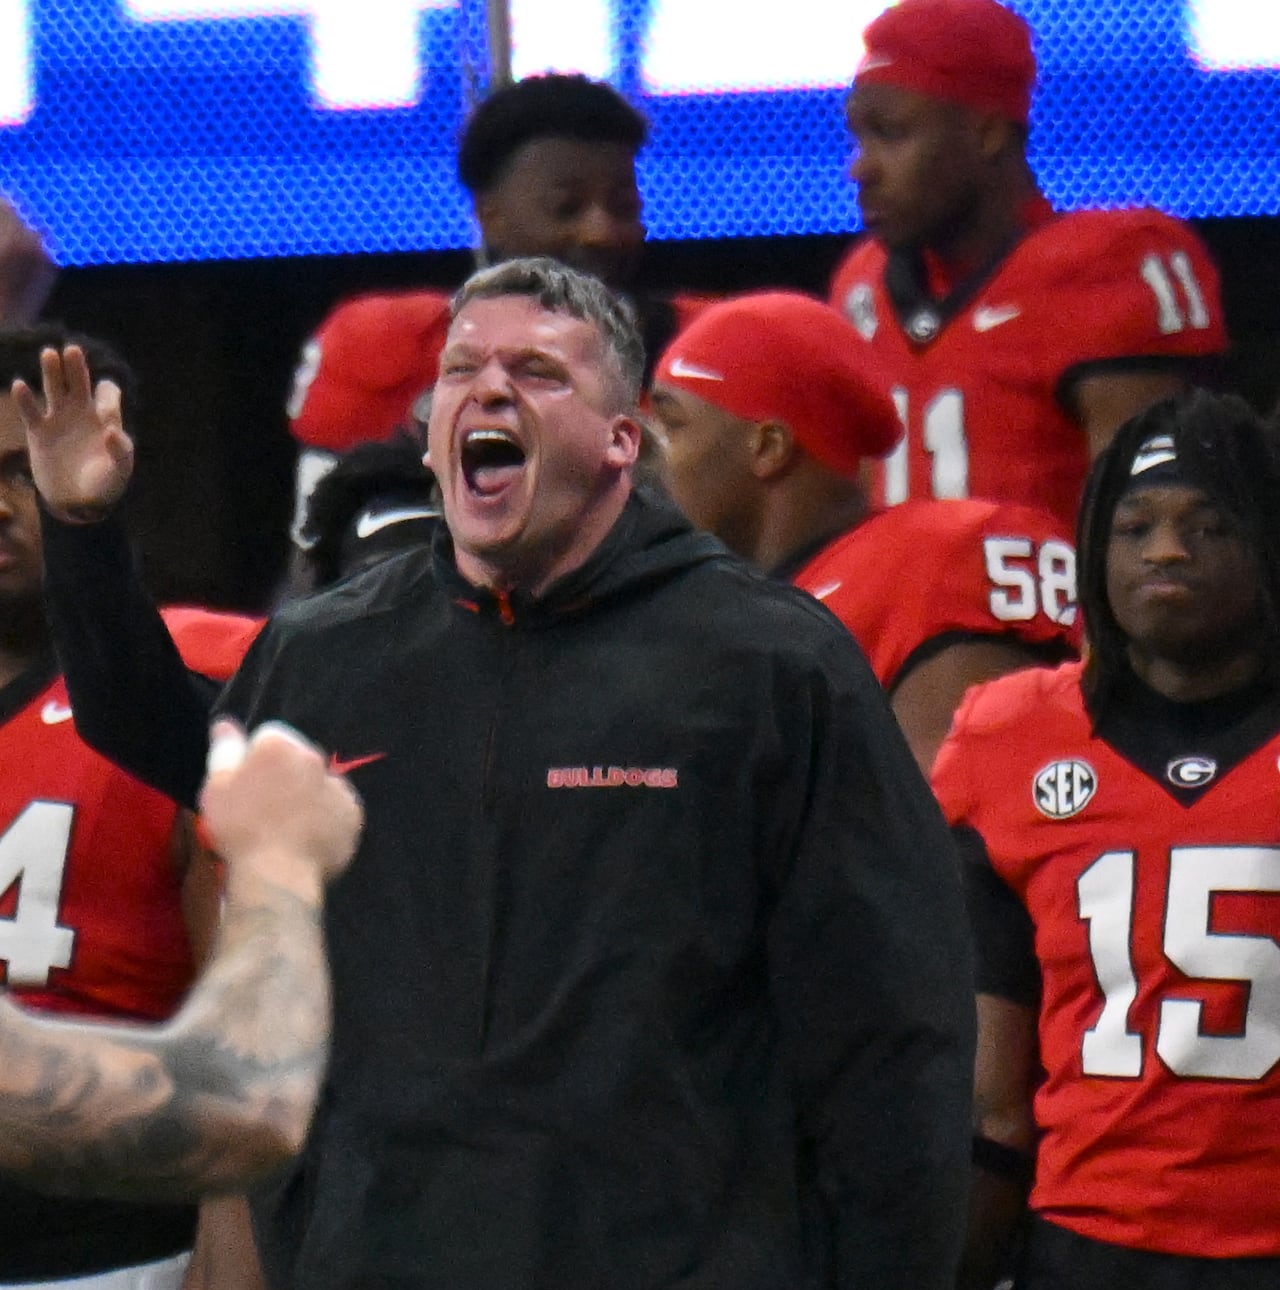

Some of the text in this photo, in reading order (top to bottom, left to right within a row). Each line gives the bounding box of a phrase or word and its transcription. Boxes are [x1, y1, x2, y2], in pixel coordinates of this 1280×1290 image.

[1141, 251, 1210, 334] 11
[983, 537, 1077, 626] 58
[547, 765, 678, 789] BULLDOGS
[1034, 761, 1096, 818] SEC
